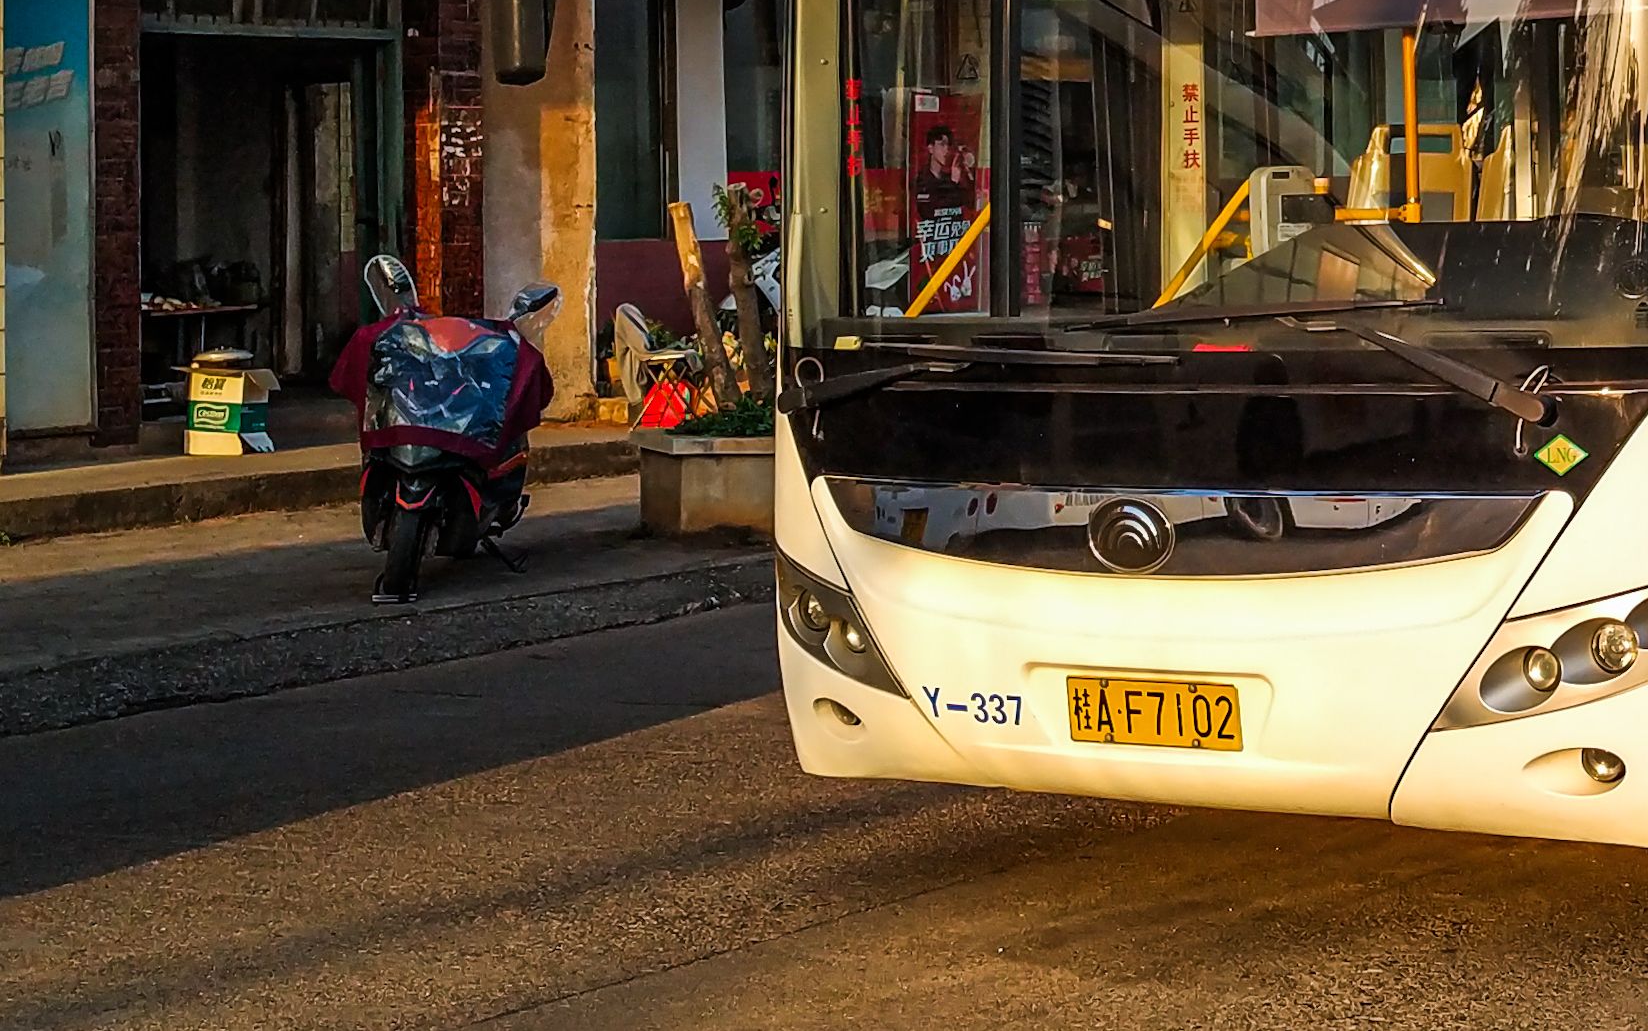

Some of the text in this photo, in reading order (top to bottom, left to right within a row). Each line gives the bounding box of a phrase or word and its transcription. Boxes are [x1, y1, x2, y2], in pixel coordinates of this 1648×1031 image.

[1182, 83, 1201, 169] 禁止手扶
[1547, 447, 1577, 464] LNG
[922, 685, 1023, 726] Y-337
